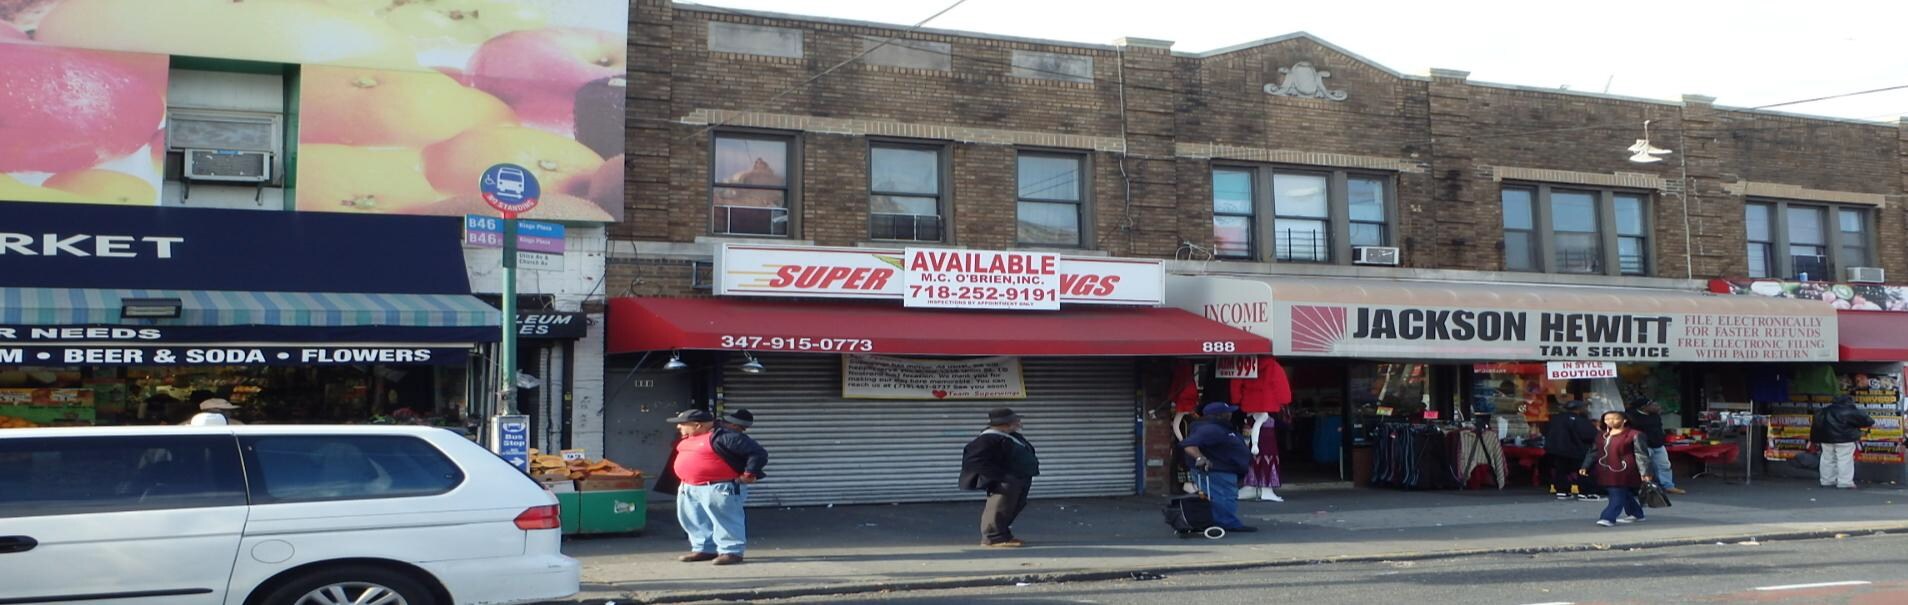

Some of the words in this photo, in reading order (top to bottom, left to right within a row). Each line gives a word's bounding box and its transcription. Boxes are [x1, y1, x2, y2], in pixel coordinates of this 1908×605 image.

[498, 199, 534, 212] STANDING
[469, 218, 496, 230] B46
[469, 232, 496, 244] B46
[911, 252, 1056, 274] AVAILABLE
[769, 264, 894, 290] SUPER
[921, 273, 950, 282] M.C.
[910, 284, 1056, 302] 718-252-9191
[1204, 302, 1268, 324] INCOME
[1352, 307, 1526, 342] JACKSON
[1540, 312, 1672, 344] HEWITT
[1684, 315, 1712, 326] FILE
[1718, 316, 1824, 327] ELECTRONICALLY
[31, 328, 162, 340] NEEDS
[1686, 326, 1709, 336] FOR
[1715, 327, 1759, 337] FASTER
[1765, 327, 1821, 337] REFUNDS
[721, 335, 873, 351] 347-915-0773
[1202, 341, 1235, 353] 888
[1678, 338, 1708, 348] FREE
[1713, 338, 1784, 349] ELECTRONIC
[1788, 339, 1824, 349] FILING
[64, 348, 143, 363] BEER
[154, 348, 176, 363] &
[186, 348, 266, 364] SODA
[302, 348, 432, 363] FLOWERS
[1540, 345, 1578, 357] TAX
[1588, 346, 1670, 358] SERVICE
[1696, 349, 1727, 358] WITH
[1733, 350, 1759, 359] PAID
[1763, 350, 1809, 359] RETURN
[1552, 369, 1613, 378] BOUTIQUE
